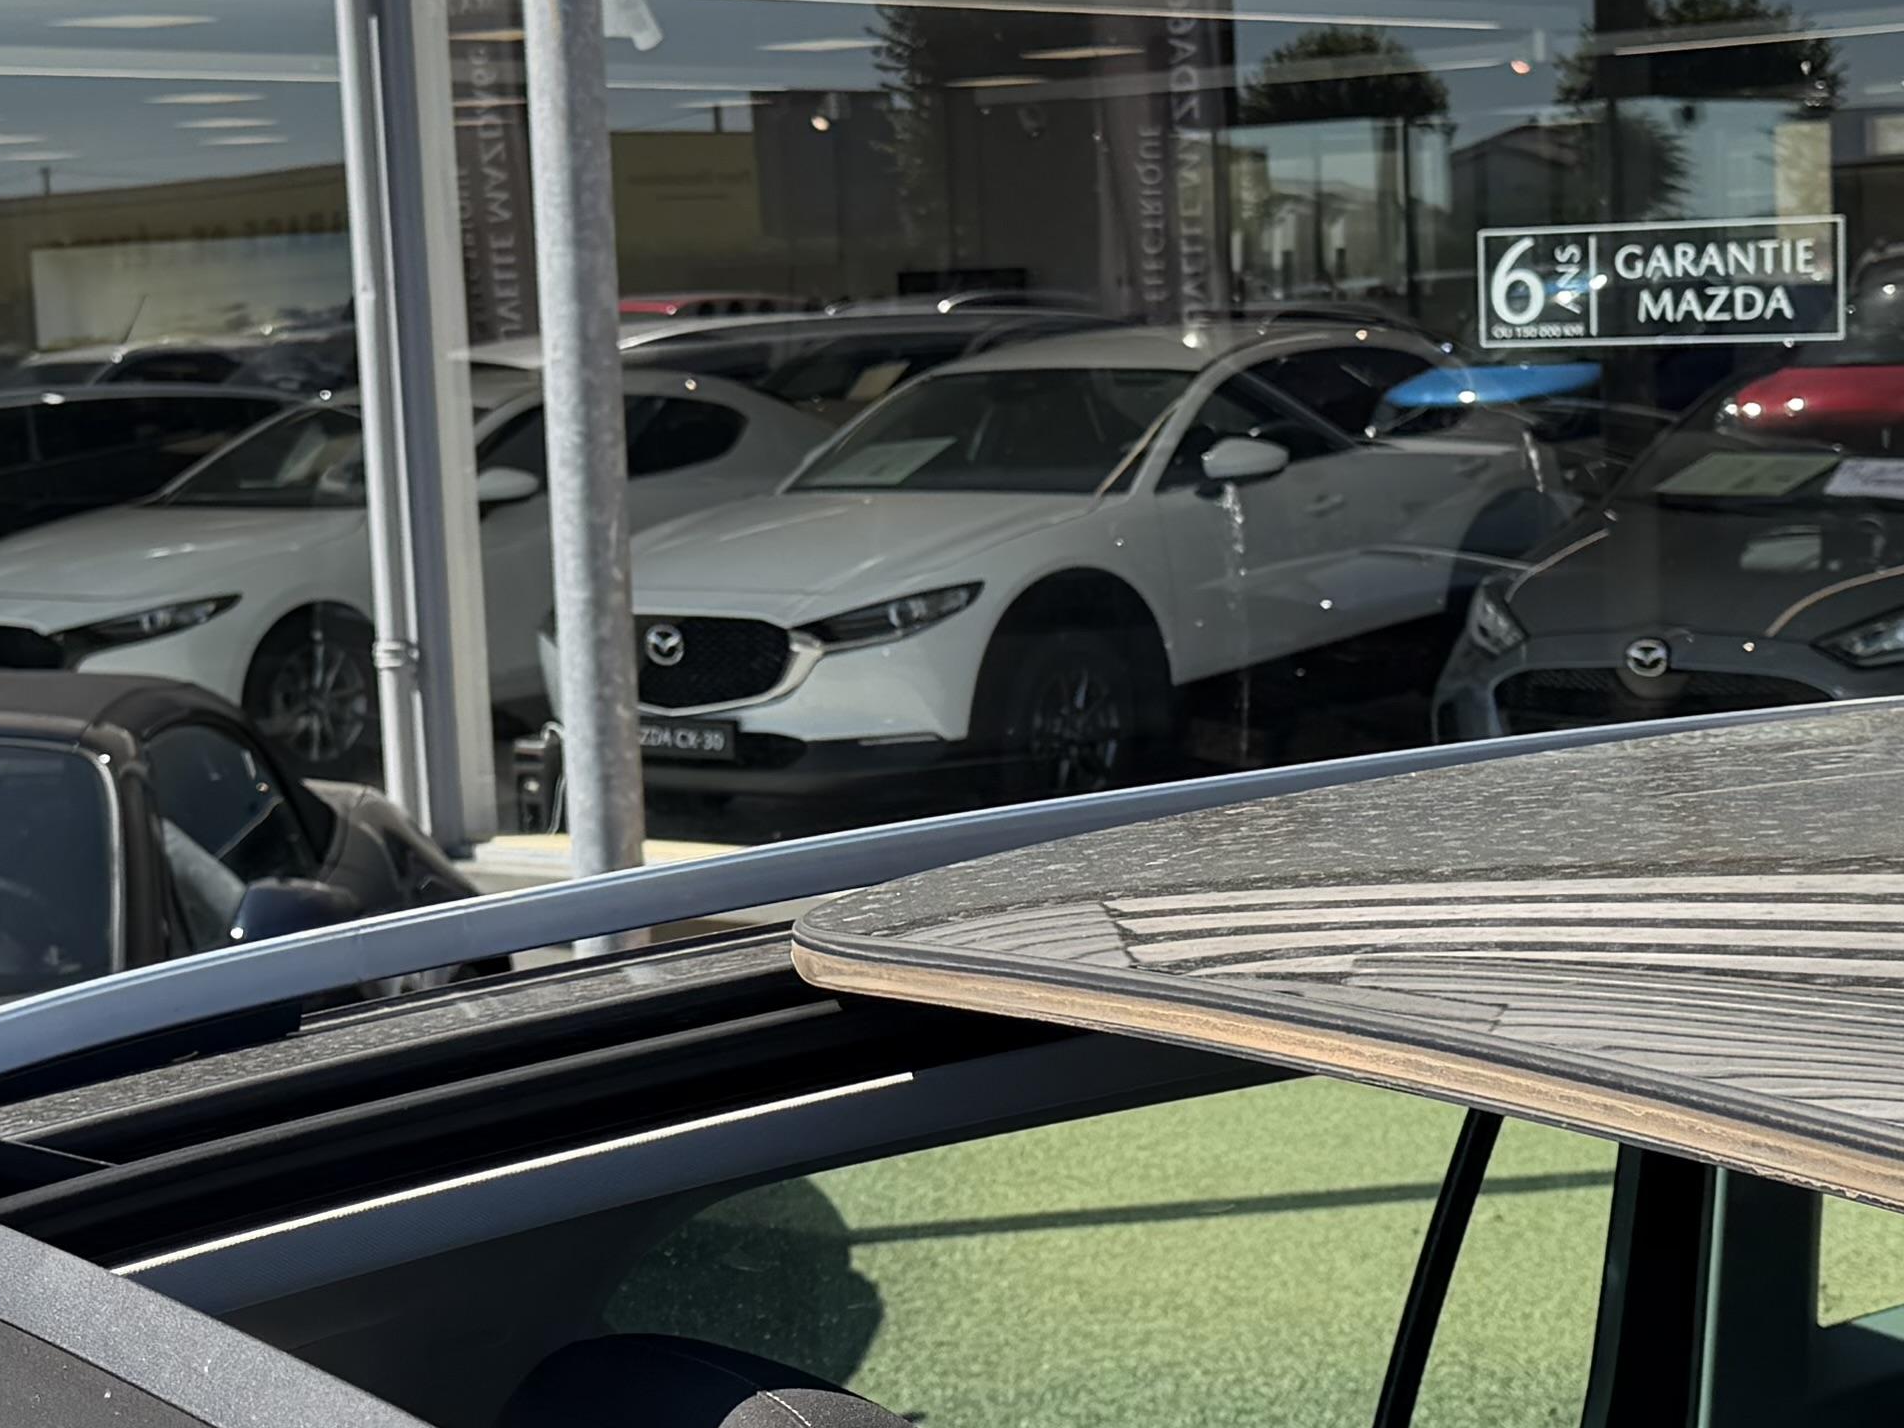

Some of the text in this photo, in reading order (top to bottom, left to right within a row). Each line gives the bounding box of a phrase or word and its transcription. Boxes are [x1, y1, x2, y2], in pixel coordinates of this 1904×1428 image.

[1614, 238, 1815, 279] GARANTIE
[1490, 235, 1545, 326] 6
[1637, 285, 1795, 323] MAZDA
